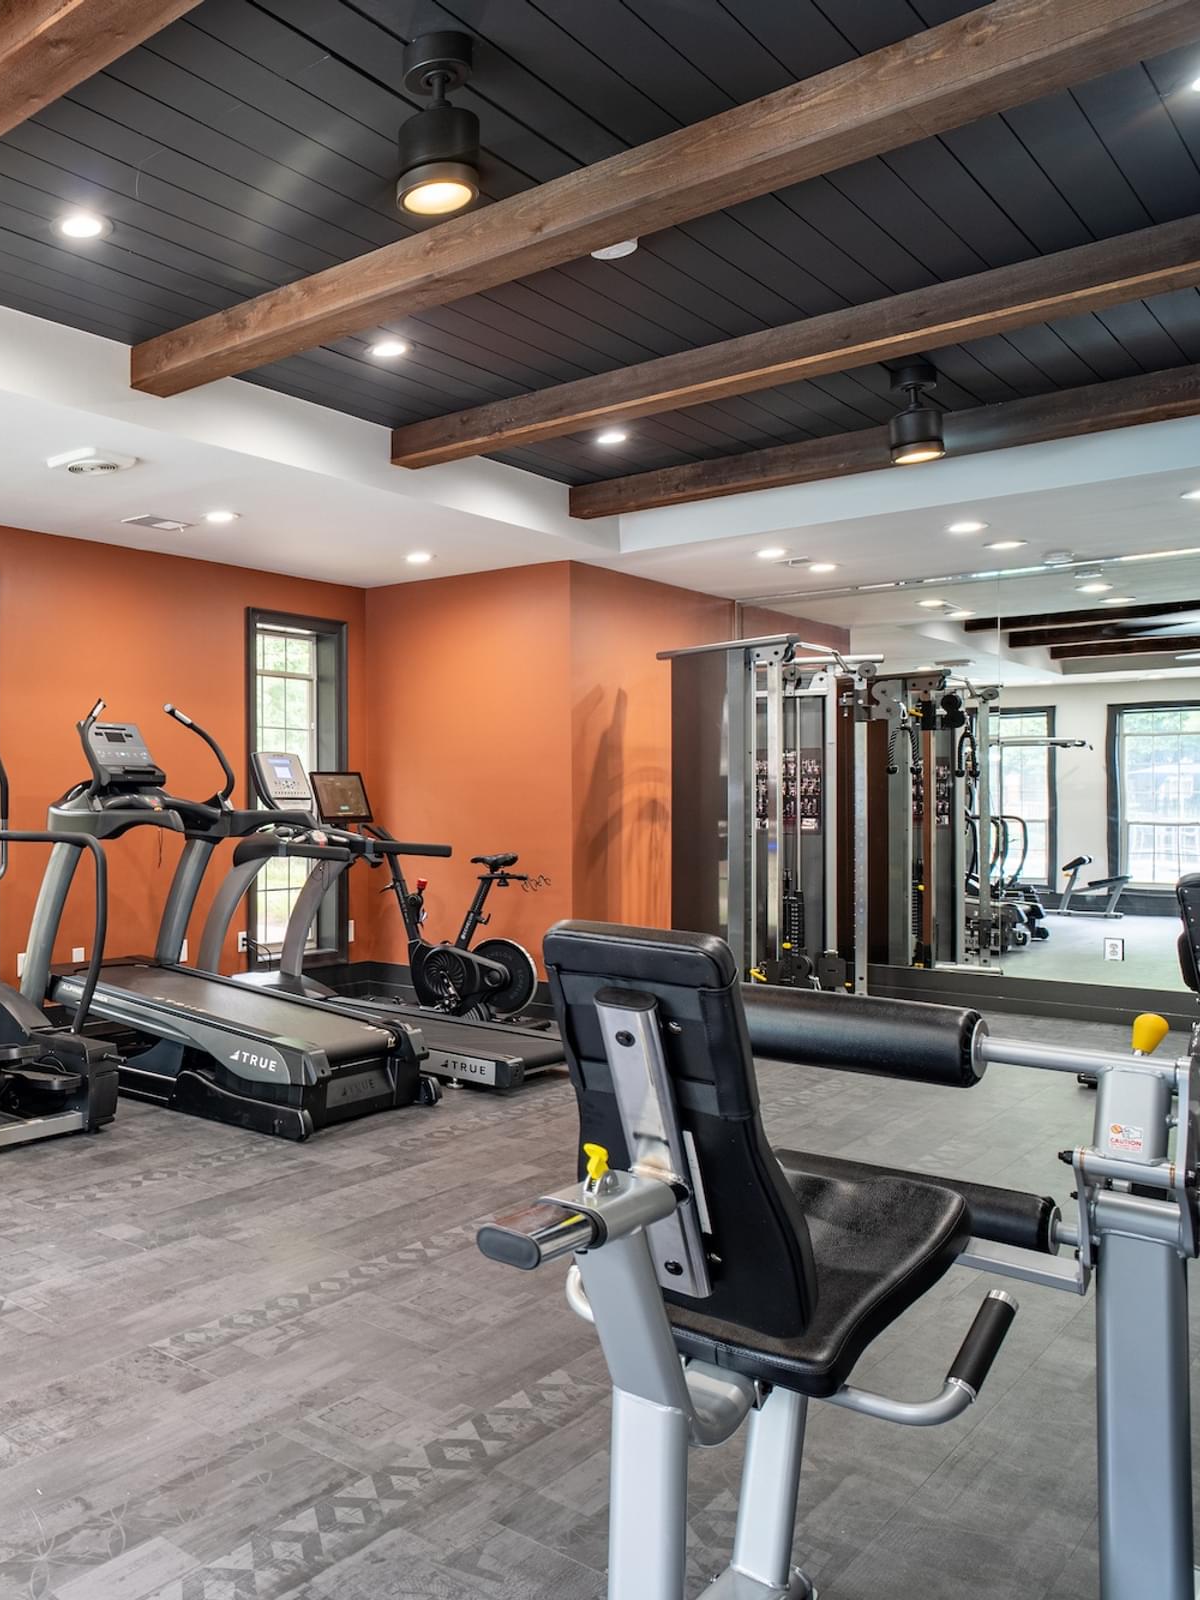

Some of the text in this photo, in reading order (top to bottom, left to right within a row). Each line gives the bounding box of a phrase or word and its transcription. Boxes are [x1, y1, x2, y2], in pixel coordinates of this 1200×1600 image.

[241, 1051, 278, 1072] TRUE
[451, 1060, 487, 1076] TRUE
[1110, 1137, 1142, 1147] CAUTION
